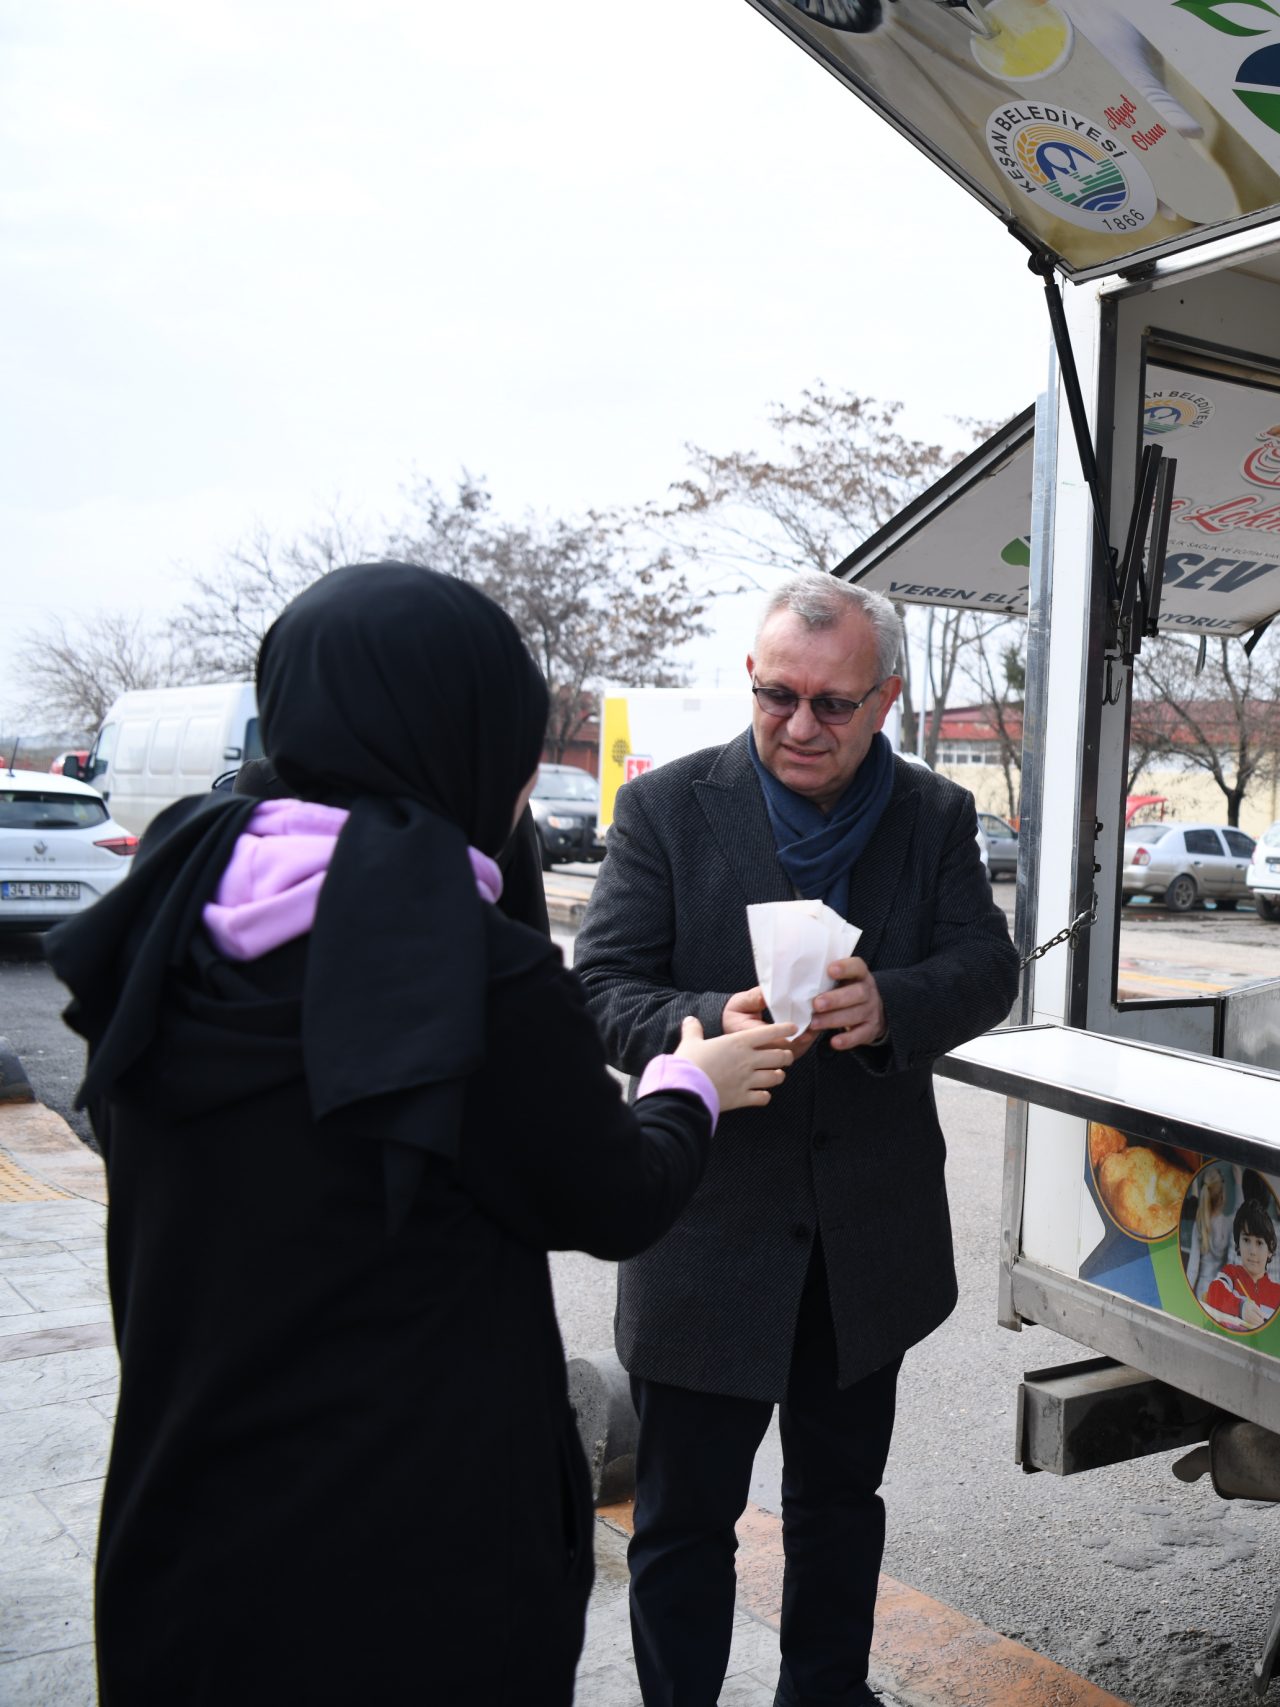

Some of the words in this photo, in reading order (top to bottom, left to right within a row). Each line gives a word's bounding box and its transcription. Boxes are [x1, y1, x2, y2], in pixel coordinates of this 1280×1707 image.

[1104, 94, 1136, 131] Afiyet
[994, 105, 1128, 159] BELEDİYESİ
[1131, 123, 1166, 151] Olsun
[991, 130, 1037, 193] KEŞAN
[1101, 208, 1145, 231] 1866
[889, 581, 977, 600] VEREN
[979, 593, 1024, 604] ELİ
